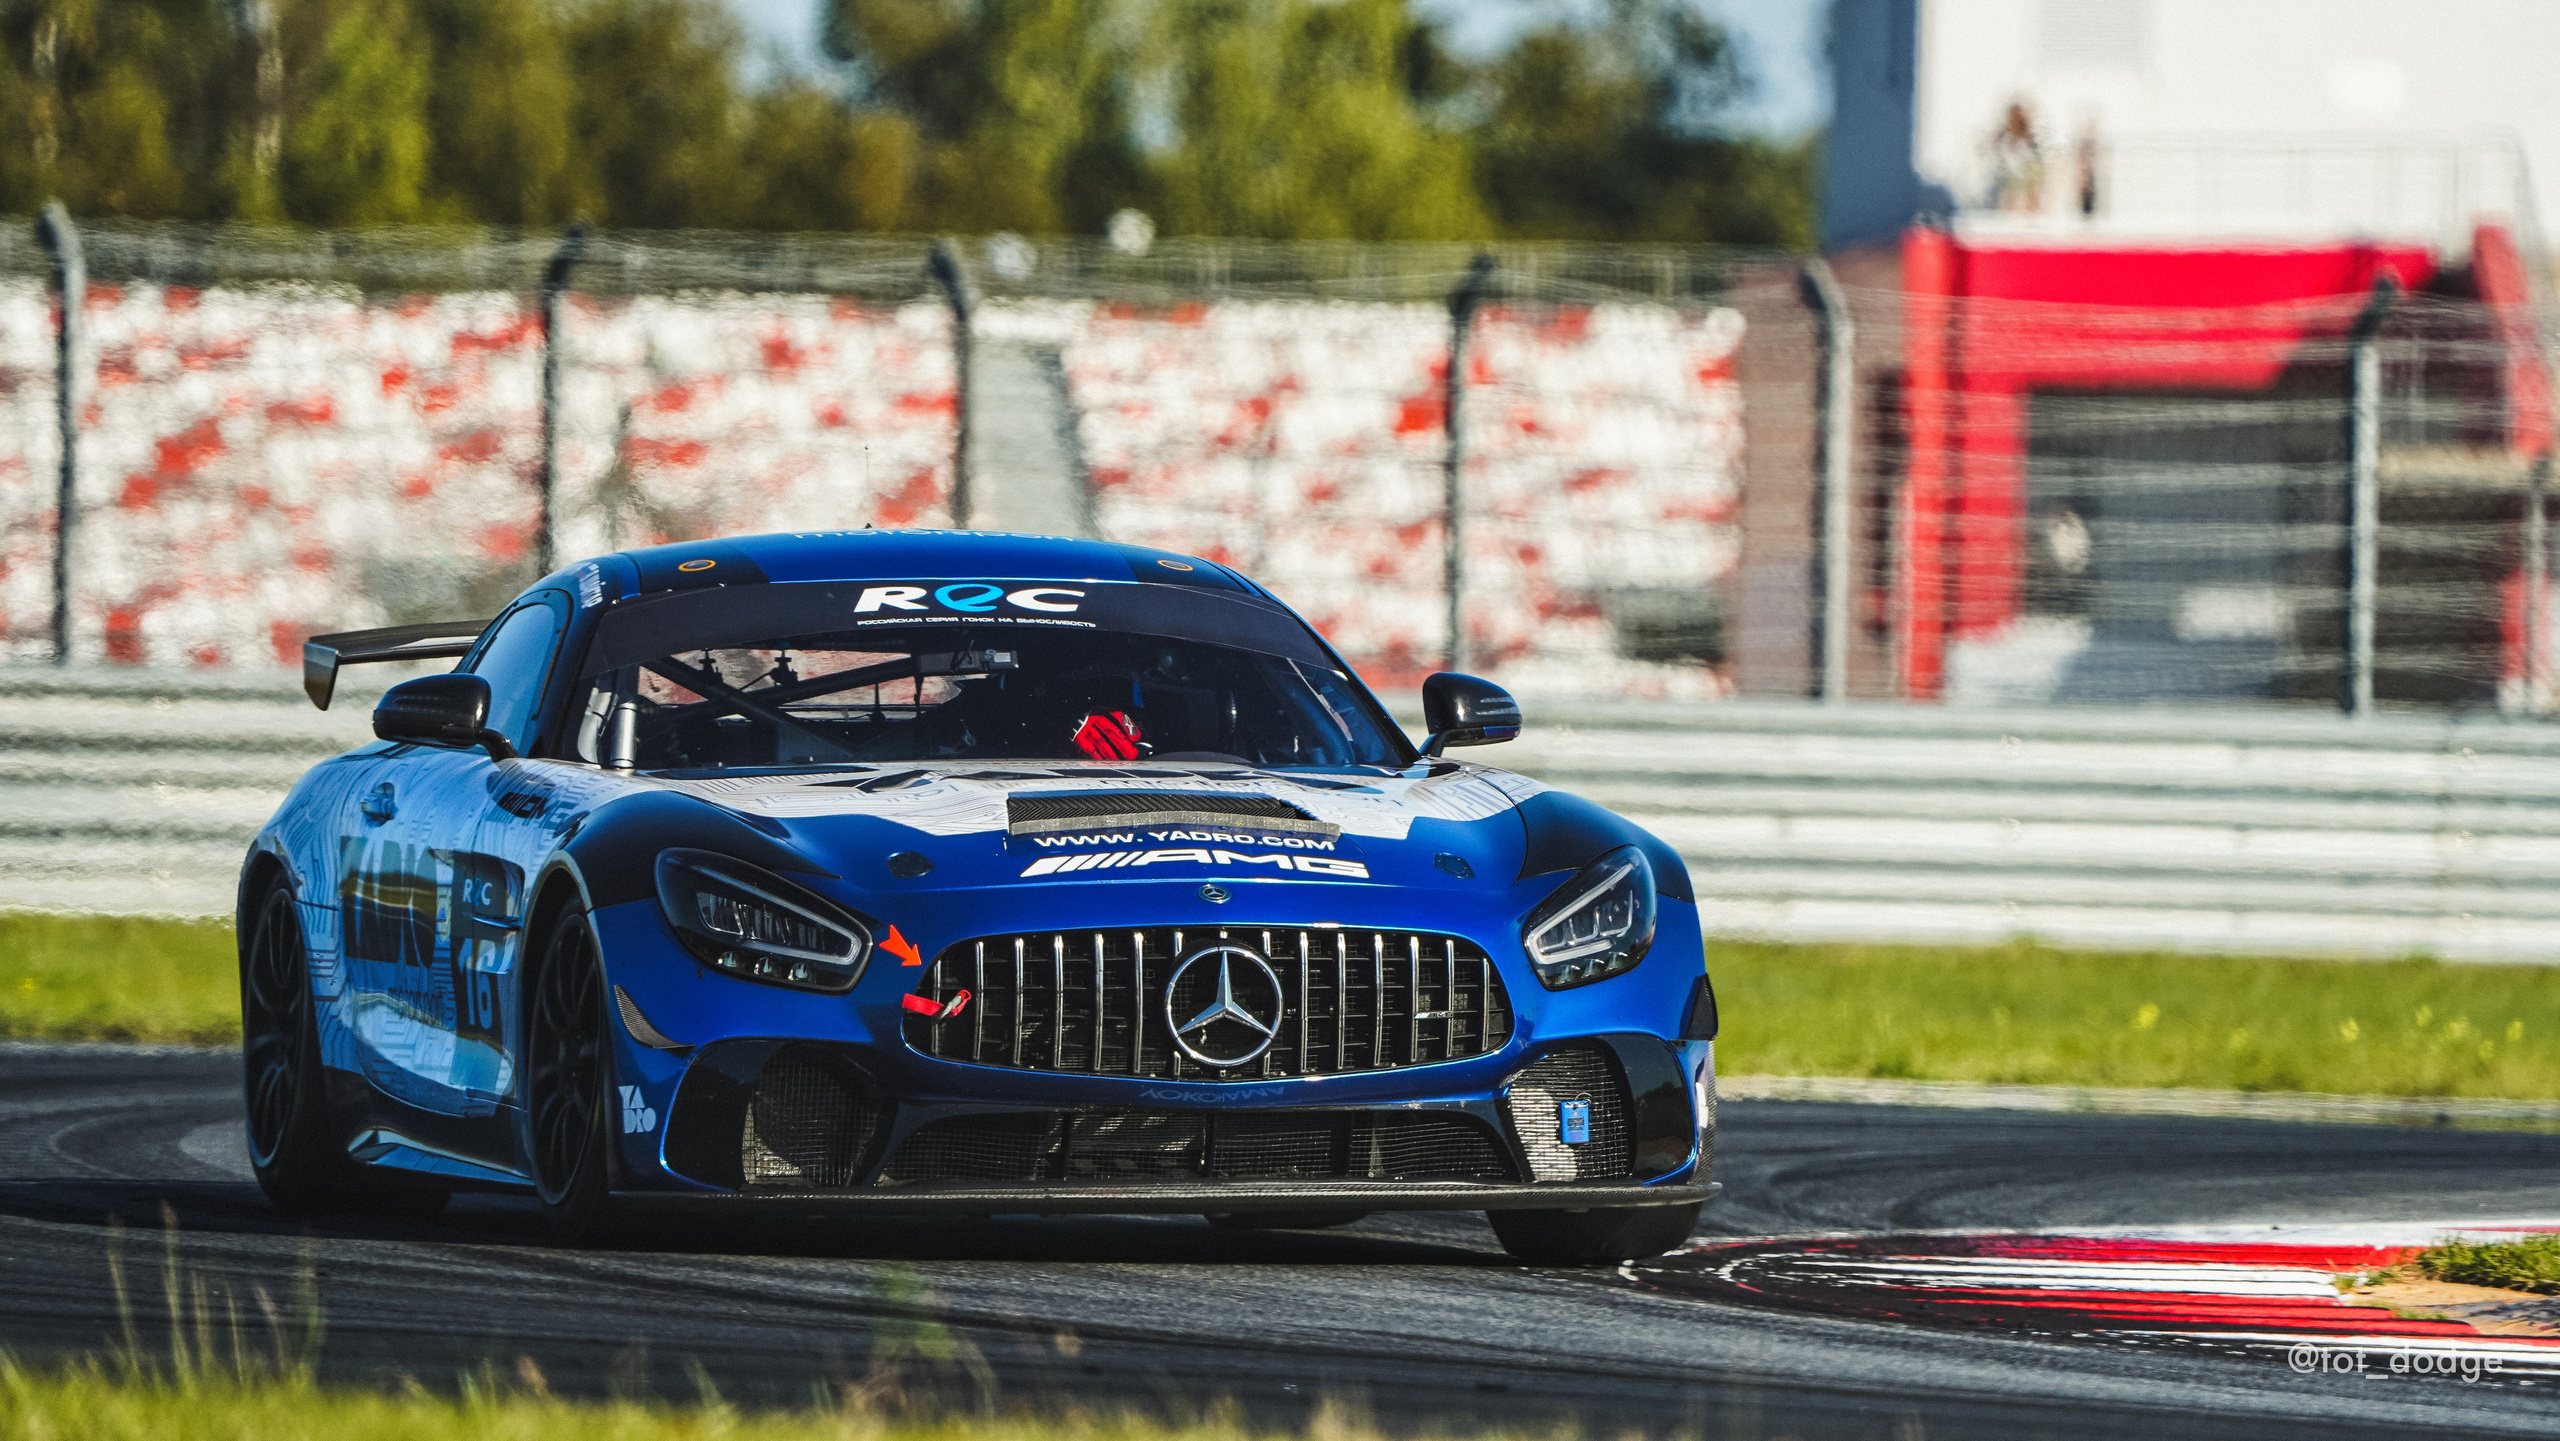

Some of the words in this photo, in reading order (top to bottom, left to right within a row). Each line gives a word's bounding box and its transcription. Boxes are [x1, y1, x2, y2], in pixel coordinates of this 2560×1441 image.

[1016, 618, 1097, 628] ВЫНОСЛИВОСТЬ
[1131, 849, 1370, 879] AMG
[458, 937, 496, 1030] 16
